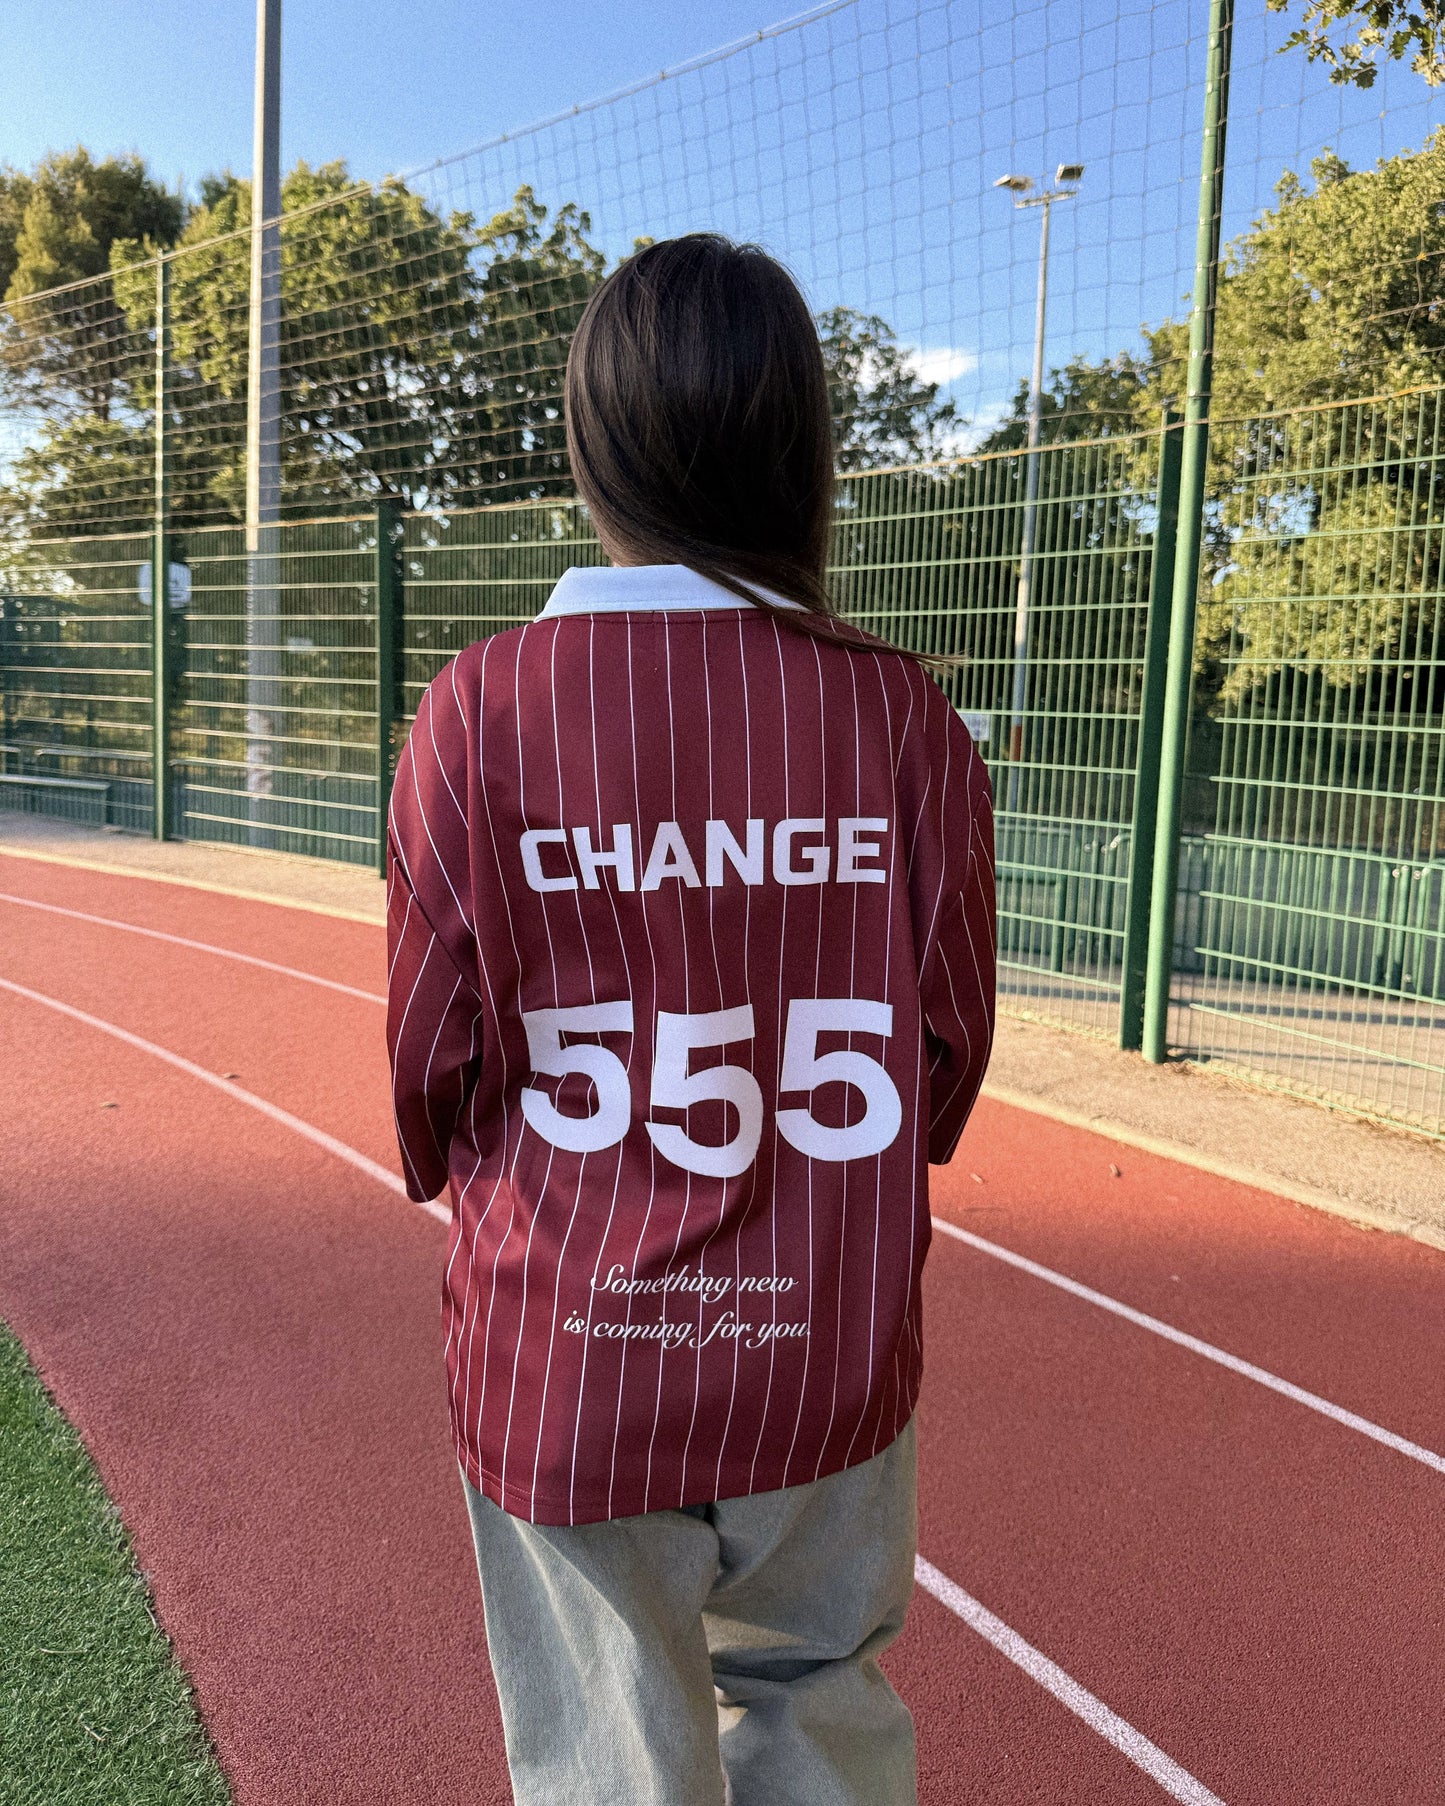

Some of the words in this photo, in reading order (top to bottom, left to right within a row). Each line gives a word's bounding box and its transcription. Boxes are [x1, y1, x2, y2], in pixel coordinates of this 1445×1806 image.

[519, 818, 888, 892] CHANGE
[520, 999, 902, 1178] 555
[590, 1264, 735, 1303] Something
[738, 1276, 799, 1293] new
[563, 1310, 588, 1334] is
[593, 1315, 697, 1349] coming
[689, 1311, 754, 1348] for
[746, 1321, 812, 1349] you.
